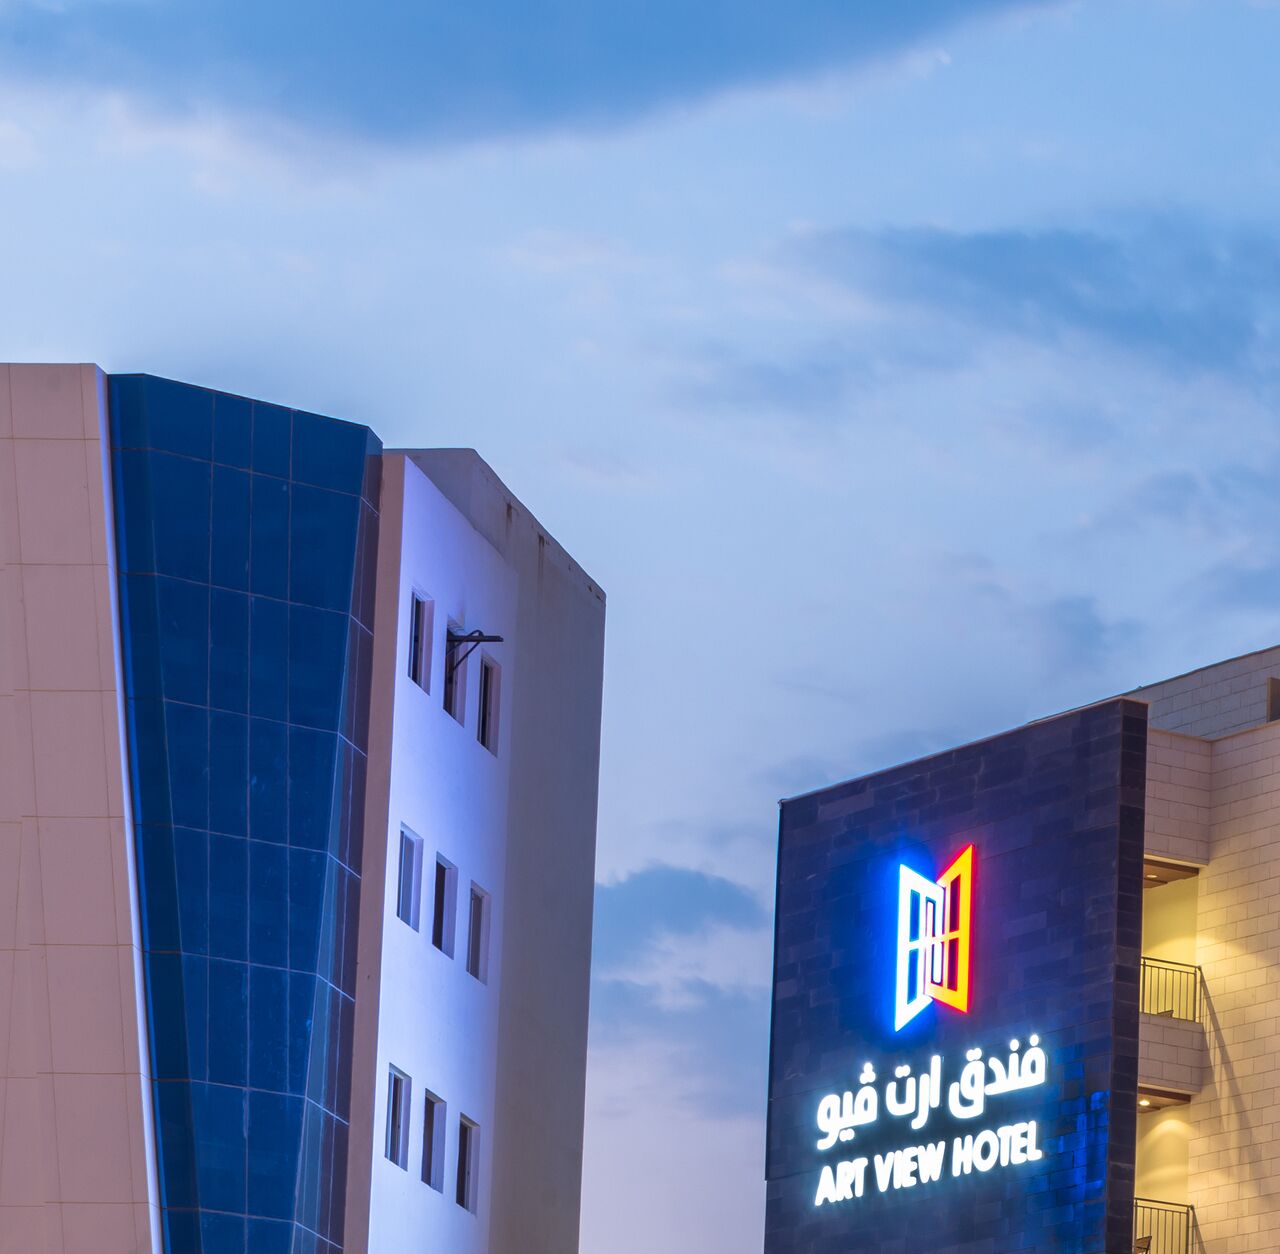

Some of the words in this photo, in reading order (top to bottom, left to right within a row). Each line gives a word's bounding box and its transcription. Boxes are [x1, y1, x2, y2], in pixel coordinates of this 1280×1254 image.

[885, 1055, 940, 1130] ارت
[948, 1034, 1046, 1119] فندق
[815, 1157, 868, 1206] ART
[874, 1141, 945, 1193] VIEW
[952, 1120, 1043, 1177] HOTEL
